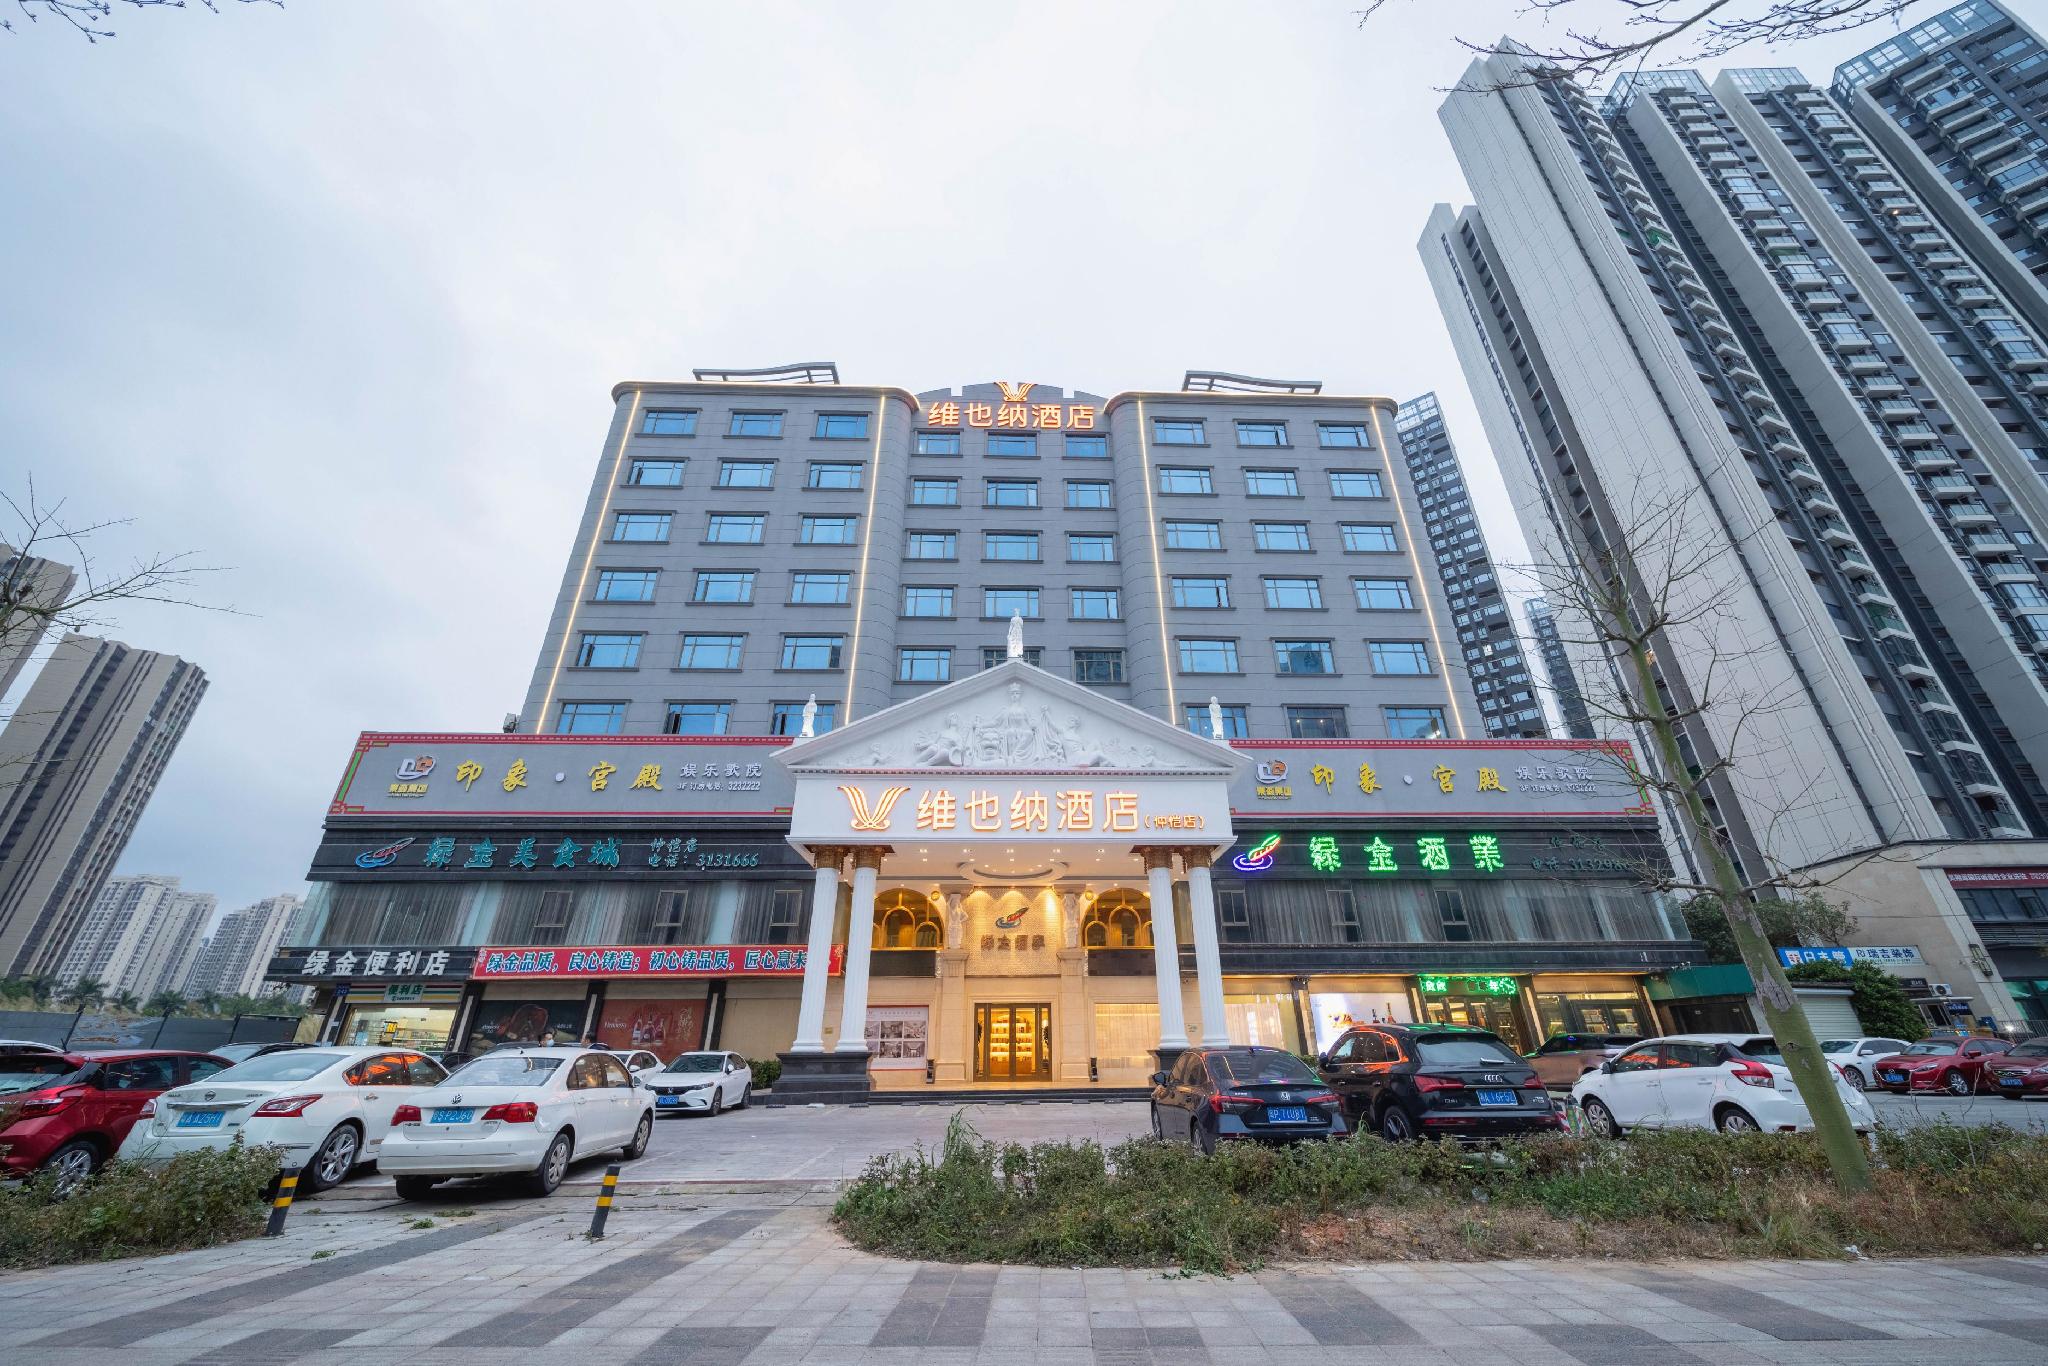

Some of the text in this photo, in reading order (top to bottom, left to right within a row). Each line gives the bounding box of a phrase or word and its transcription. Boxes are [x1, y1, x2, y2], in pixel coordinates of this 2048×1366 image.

[928, 402, 1094, 429] 维也纳酒店
[916, 790, 1139, 832] 维也纳酒店
[696, 853, 759, 867] 3131666
[302, 950, 450, 976] 绿金便利店
[388, 984, 424, 996] 便利店
